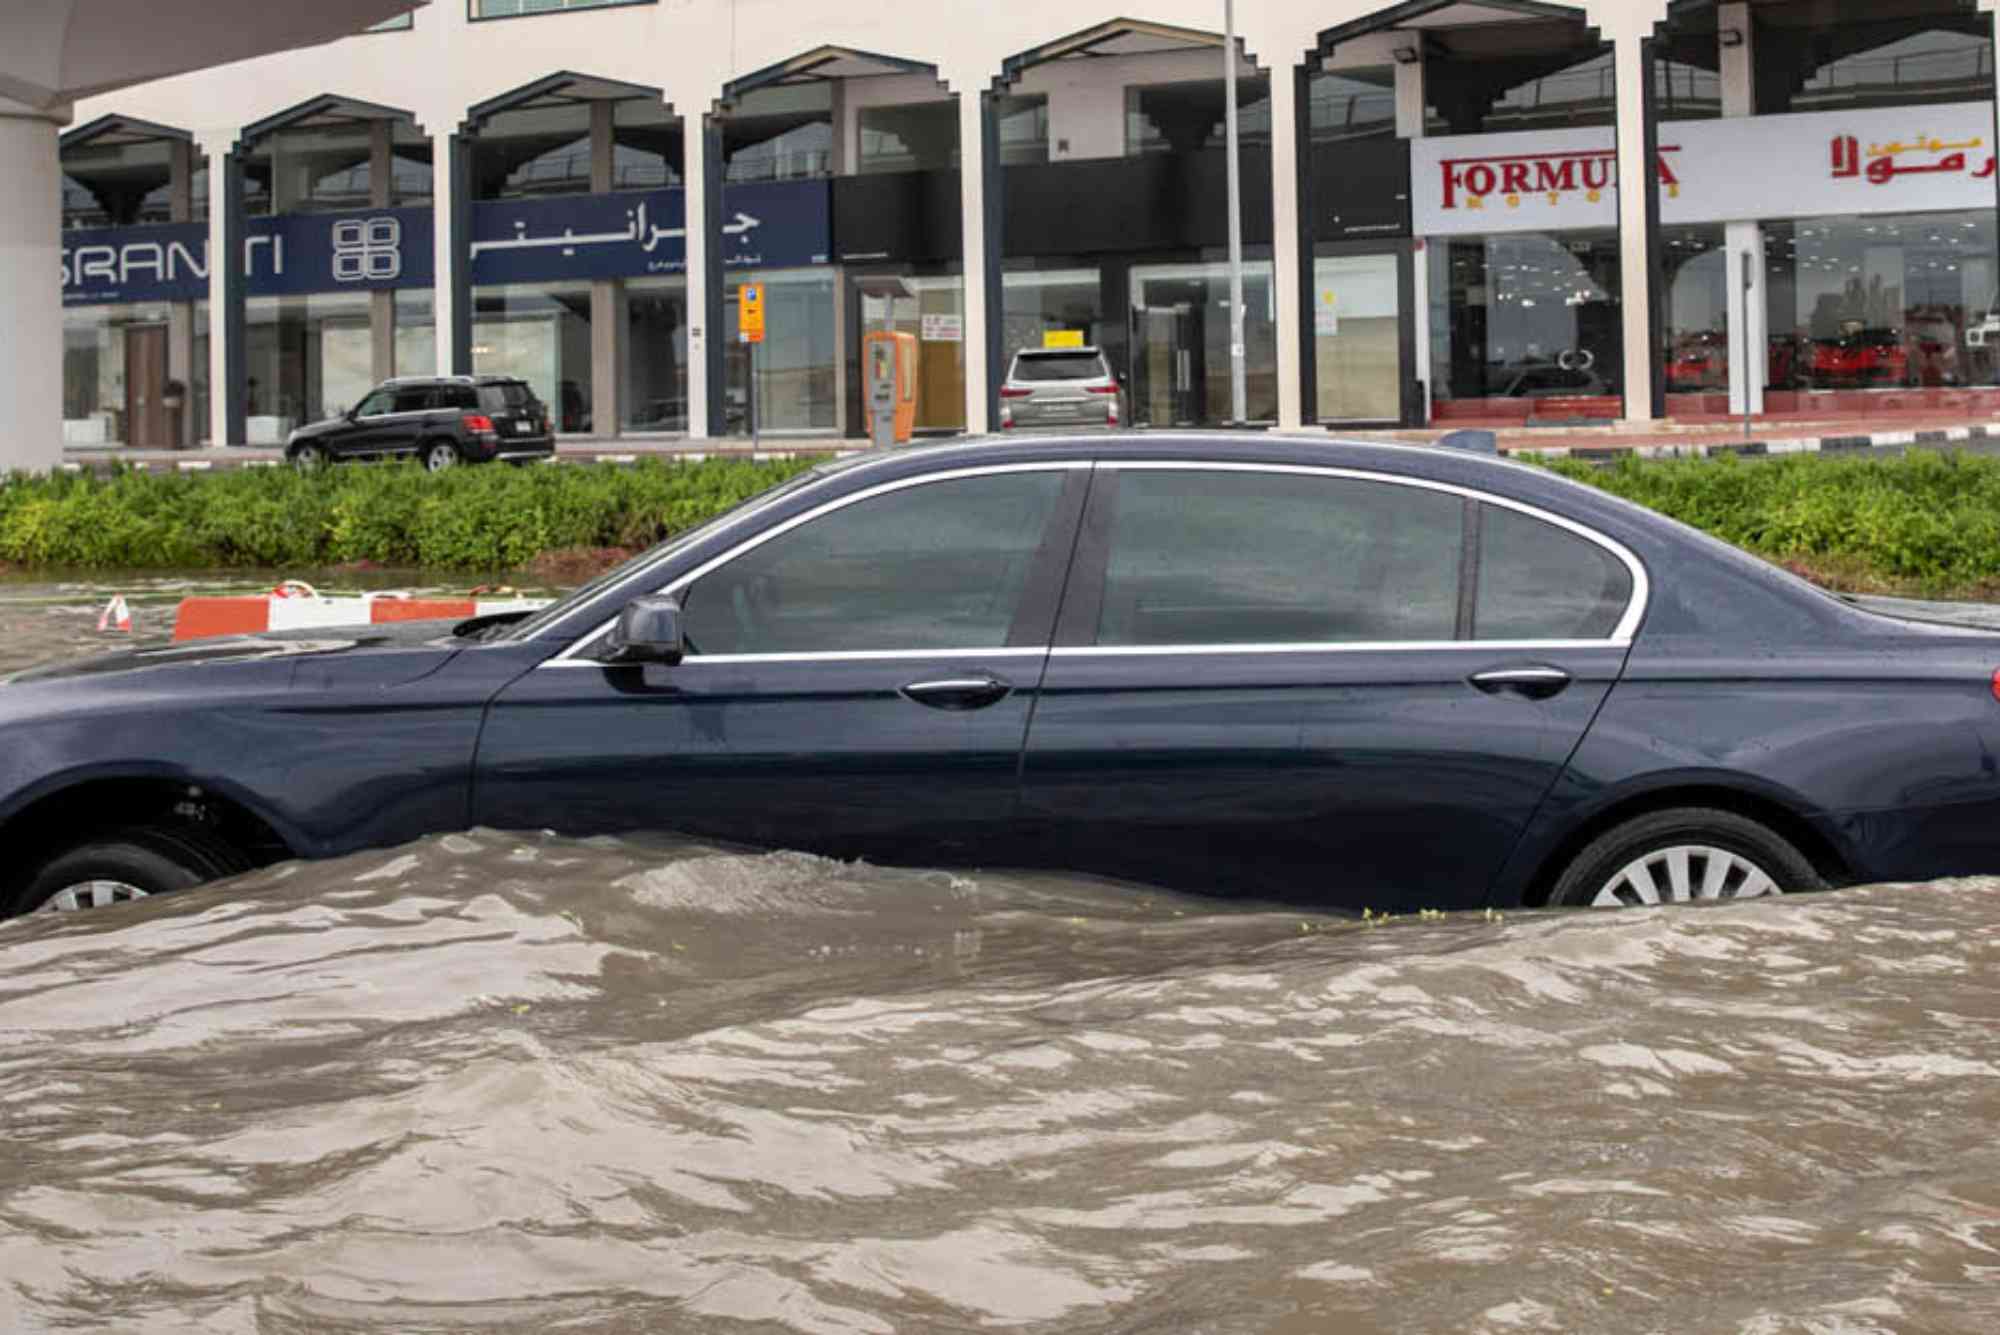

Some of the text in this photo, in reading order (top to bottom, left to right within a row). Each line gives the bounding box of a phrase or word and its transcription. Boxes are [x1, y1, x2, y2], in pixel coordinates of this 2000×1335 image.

[1439, 145, 1682, 209] FORMUA
[1465, 183, 1681, 209] MOTOS
[62, 234, 283, 287] RANTI
